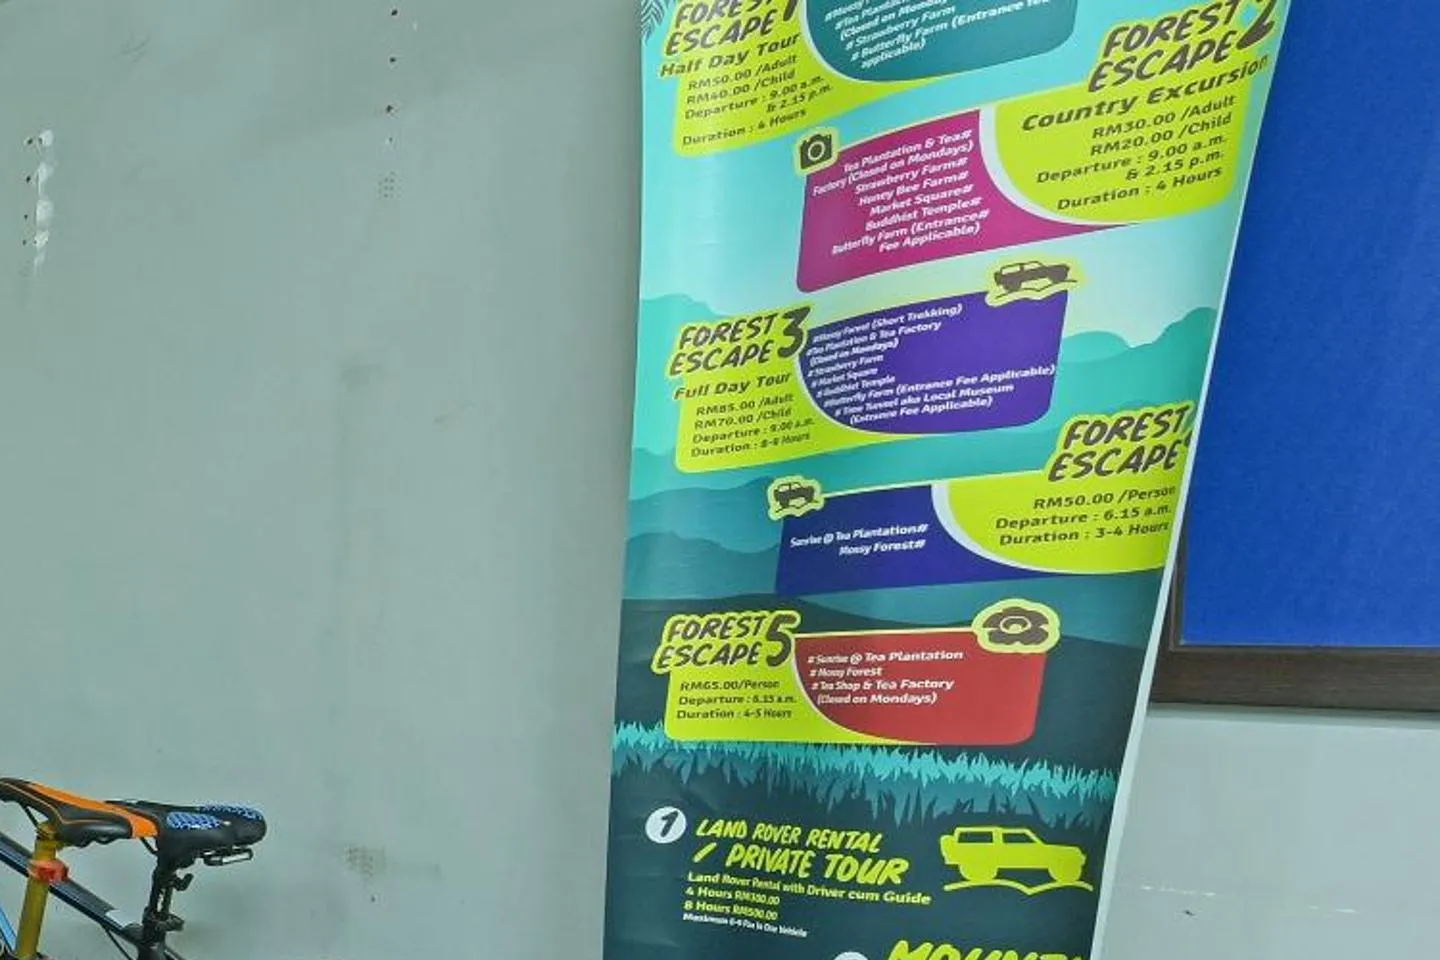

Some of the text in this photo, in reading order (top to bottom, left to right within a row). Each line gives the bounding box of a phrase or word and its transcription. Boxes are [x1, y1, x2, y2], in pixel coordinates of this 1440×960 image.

[665, 8, 778, 56] ESCAPE
[1103, 0, 1239, 58] FOREST
[660, 33, 800, 77] Half Day Tour
[1087, 30, 1238, 93] ESCAPE
[1022, 54, 1270, 131] Country Excursion
[685, 97, 758, 120] Departure
[1092, 95, 1236, 138] RM30.00 /Adult
[683, 126, 746, 146] Duration
[1090, 112, 1232, 156] RM20.00 /Child
[1036, 143, 1188, 184] Departure 9.00
[1057, 166, 1222, 210] Duration Hours
[679, 305, 811, 358] FOREST 3
[898, 321, 942, 335] Factory
[670, 340, 774, 376] ESCAPE
[673, 372, 791, 400] Full Day Tour
[980, 365, 1056, 383] Applicable)
[921, 383, 1015, 402] Local Museum
[921, 397, 993, 414] Applicable)
[692, 427, 760, 444] Departure
[1063, 405, 1191, 450] FOREST
[690, 442, 751, 458] Duration
[1048, 440, 1182, 482] ESCAPE
[1033, 485, 1176, 510] RM50.00 /Person
[995, 514, 1088, 531] Departure
[1000, 521, 1170, 546] Duration 3-4 Hours
[666, 614, 797, 667] FOREST 5
[657, 641, 763, 669] ESCAPE
[865, 650, 964, 662] Tea Plantation
[846, 666, 883, 677] Forest
[876, 679, 955, 691] Tea Factory
[679, 695, 744, 707] Departure
[869, 691, 938, 706] Mondays)
[677, 708, 734, 719] Duration
[696, 818, 883, 854] LAND ROVER RENTAL
[725, 843, 910, 886] PRIVATE TOUR
[688, 870, 932, 906] Land Driver cum Guide
[697, 886, 732, 899] Hours
[696, 901, 731, 913] Hours
